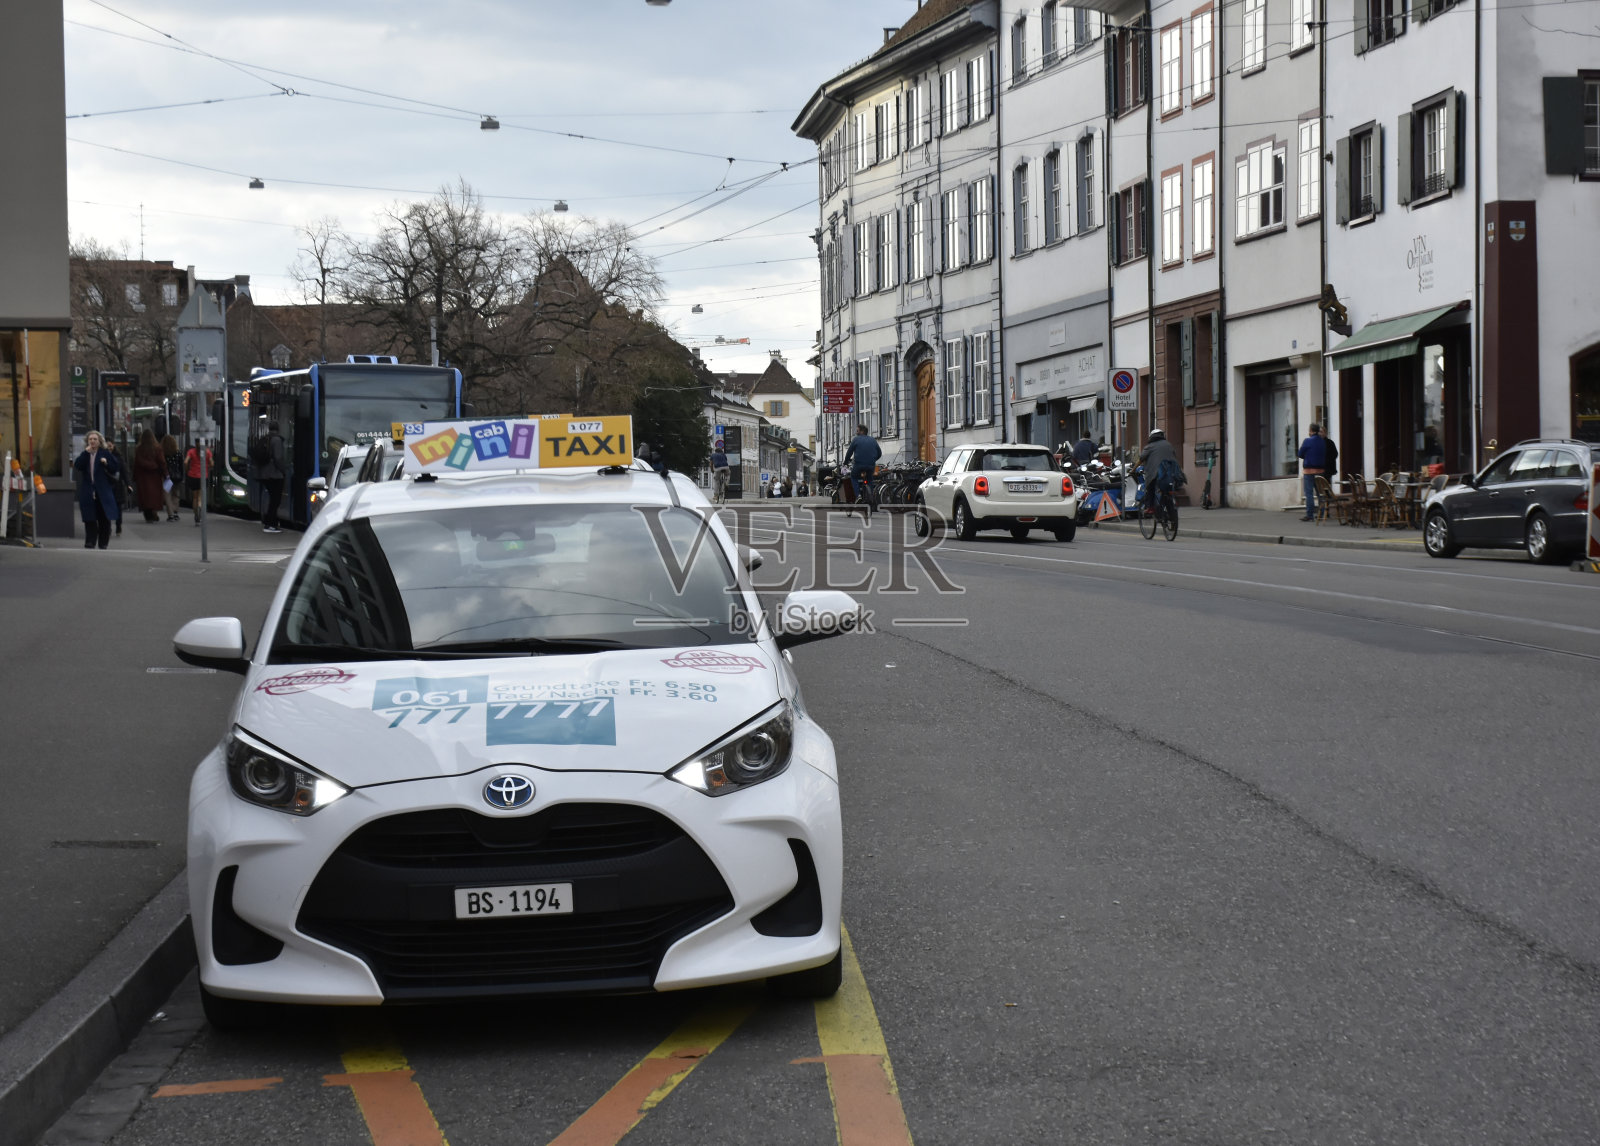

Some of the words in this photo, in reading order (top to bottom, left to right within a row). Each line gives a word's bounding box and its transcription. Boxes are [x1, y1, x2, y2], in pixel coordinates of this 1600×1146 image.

[1111, 400, 1135, 408] Vorfahrt
[474, 424, 504, 439] cab
[417, 427, 529, 466] mini
[545, 434, 626, 457] TAXI
[667, 656, 760, 667] ORIGINAL
[493, 679, 620, 692] Grundtaxe
[629, 679, 656, 687] Fr.
[665, 680, 717, 693] 6.50
[391, 689, 468, 706] 061
[490, 687, 619, 701] Tag/Nacht
[630, 687, 657, 697] Fr.
[666, 689, 718, 703] 3.60
[385, 705, 471, 729] 777
[489, 698, 610, 720] 7777
